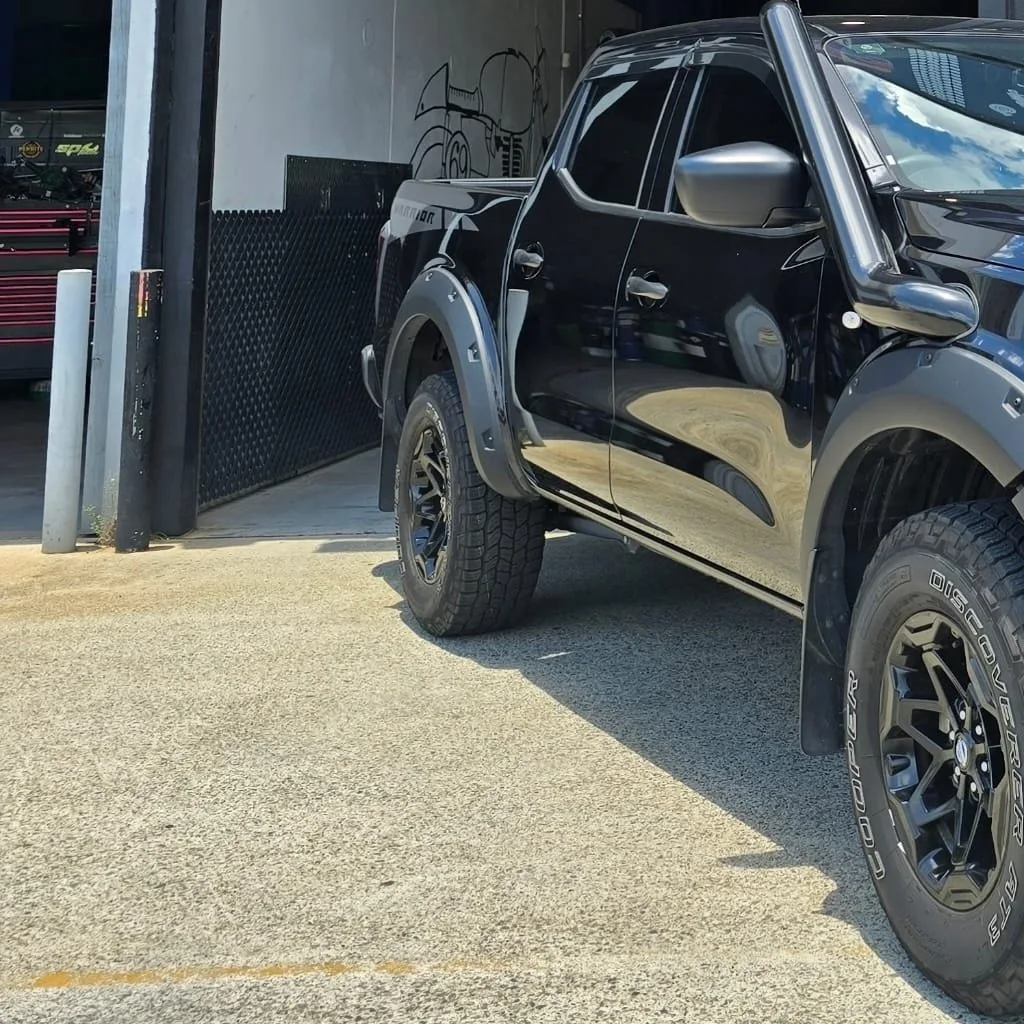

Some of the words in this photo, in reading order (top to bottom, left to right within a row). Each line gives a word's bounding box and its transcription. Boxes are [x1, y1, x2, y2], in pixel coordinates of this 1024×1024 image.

[846, 670, 885, 880] COOPER
[929, 569, 1024, 846] DISCOVERER
[988, 861, 1018, 946] AT3
